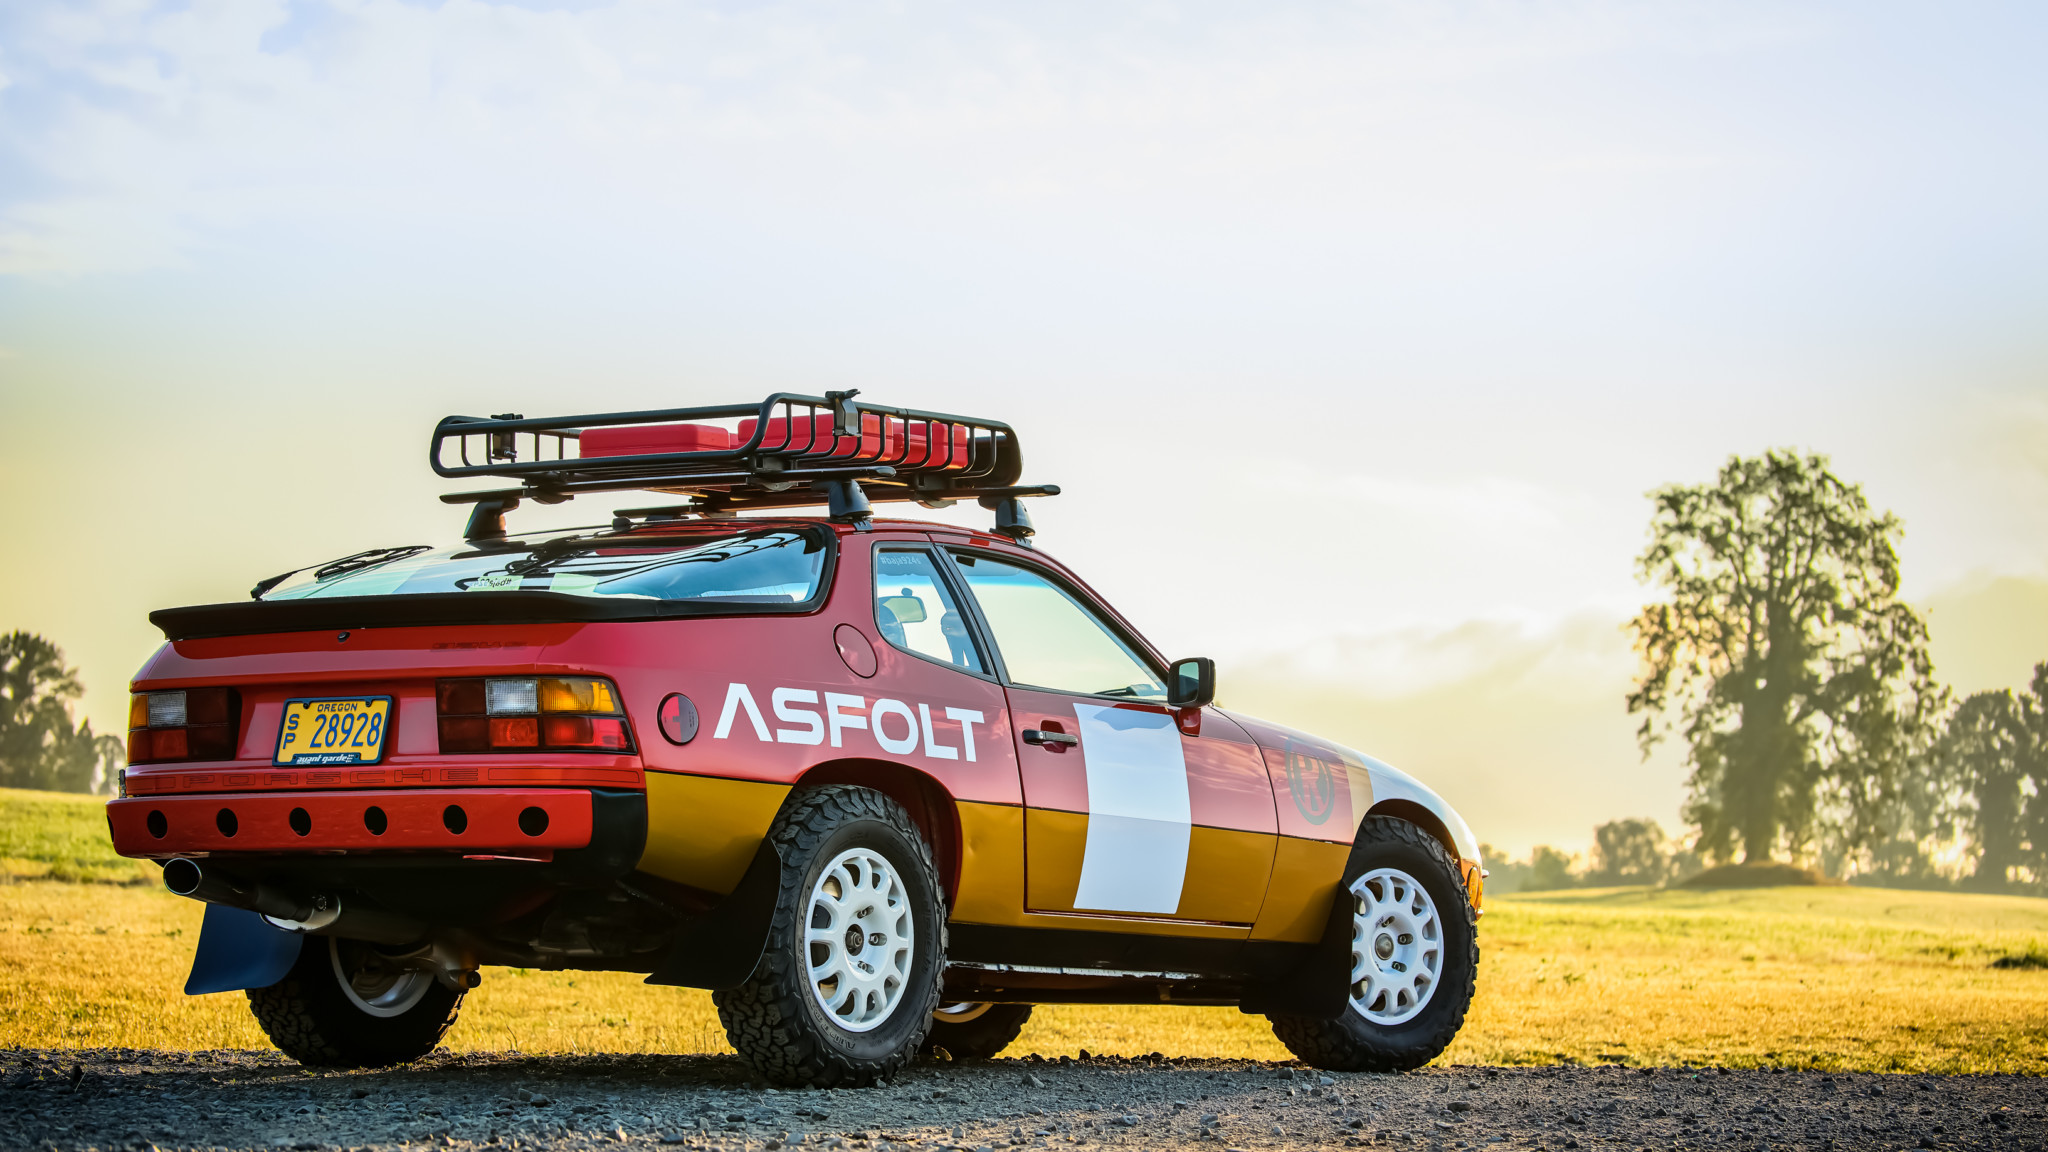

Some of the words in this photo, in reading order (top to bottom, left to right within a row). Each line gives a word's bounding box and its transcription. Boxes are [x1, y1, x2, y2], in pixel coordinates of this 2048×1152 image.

[317, 703, 358, 712] OREGON
[309, 712, 383, 748] 28928
[713, 682, 985, 763] ASFOLT
[296, 754, 322, 764] avant
[322, 754, 348, 765] garde
[185, 768, 479, 788] PORSCHE
